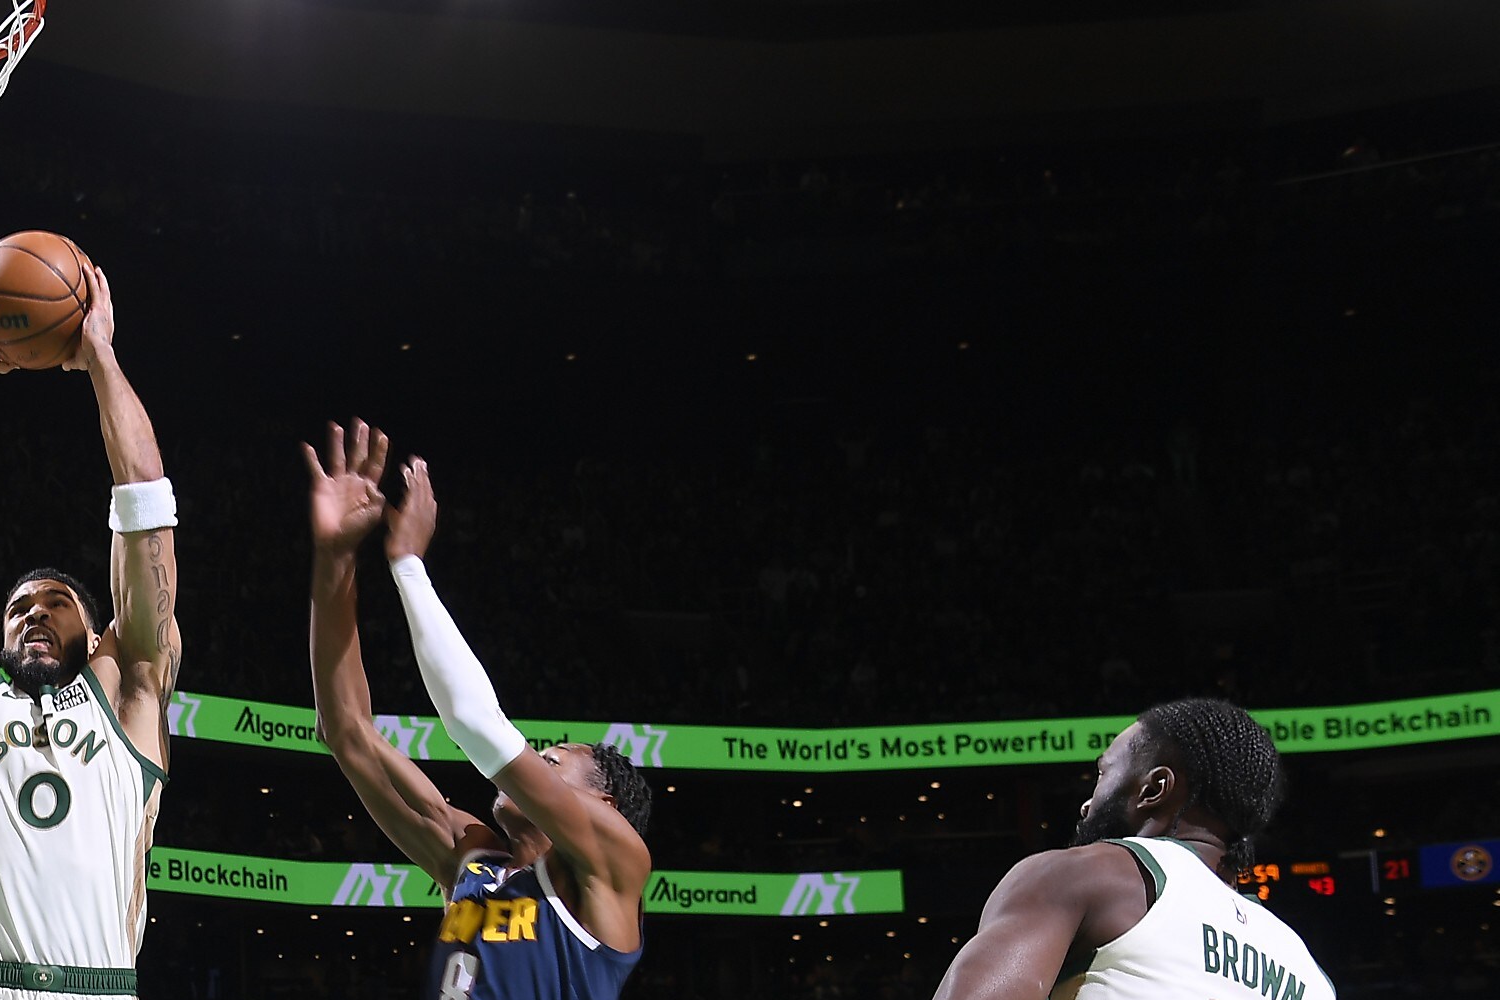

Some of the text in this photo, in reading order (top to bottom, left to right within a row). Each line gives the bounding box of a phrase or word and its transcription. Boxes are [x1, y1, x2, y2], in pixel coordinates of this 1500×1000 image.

[53, 683, 83, 705] VISTA
[55, 694, 88, 712] PRINT
[234, 705, 321, 742] Algoran
[1323, 704, 1492, 740] Blockchain
[723, 737, 768, 761] The
[776, 738, 871, 762] World's
[880, 735, 947, 759] Most
[954, 728, 1075, 756] Powerful
[17, 770, 72, 831] 0
[168, 858, 288, 893] Blockchain
[1384, 859, 1410, 880] 21
[649, 876, 758, 909] Algorand
